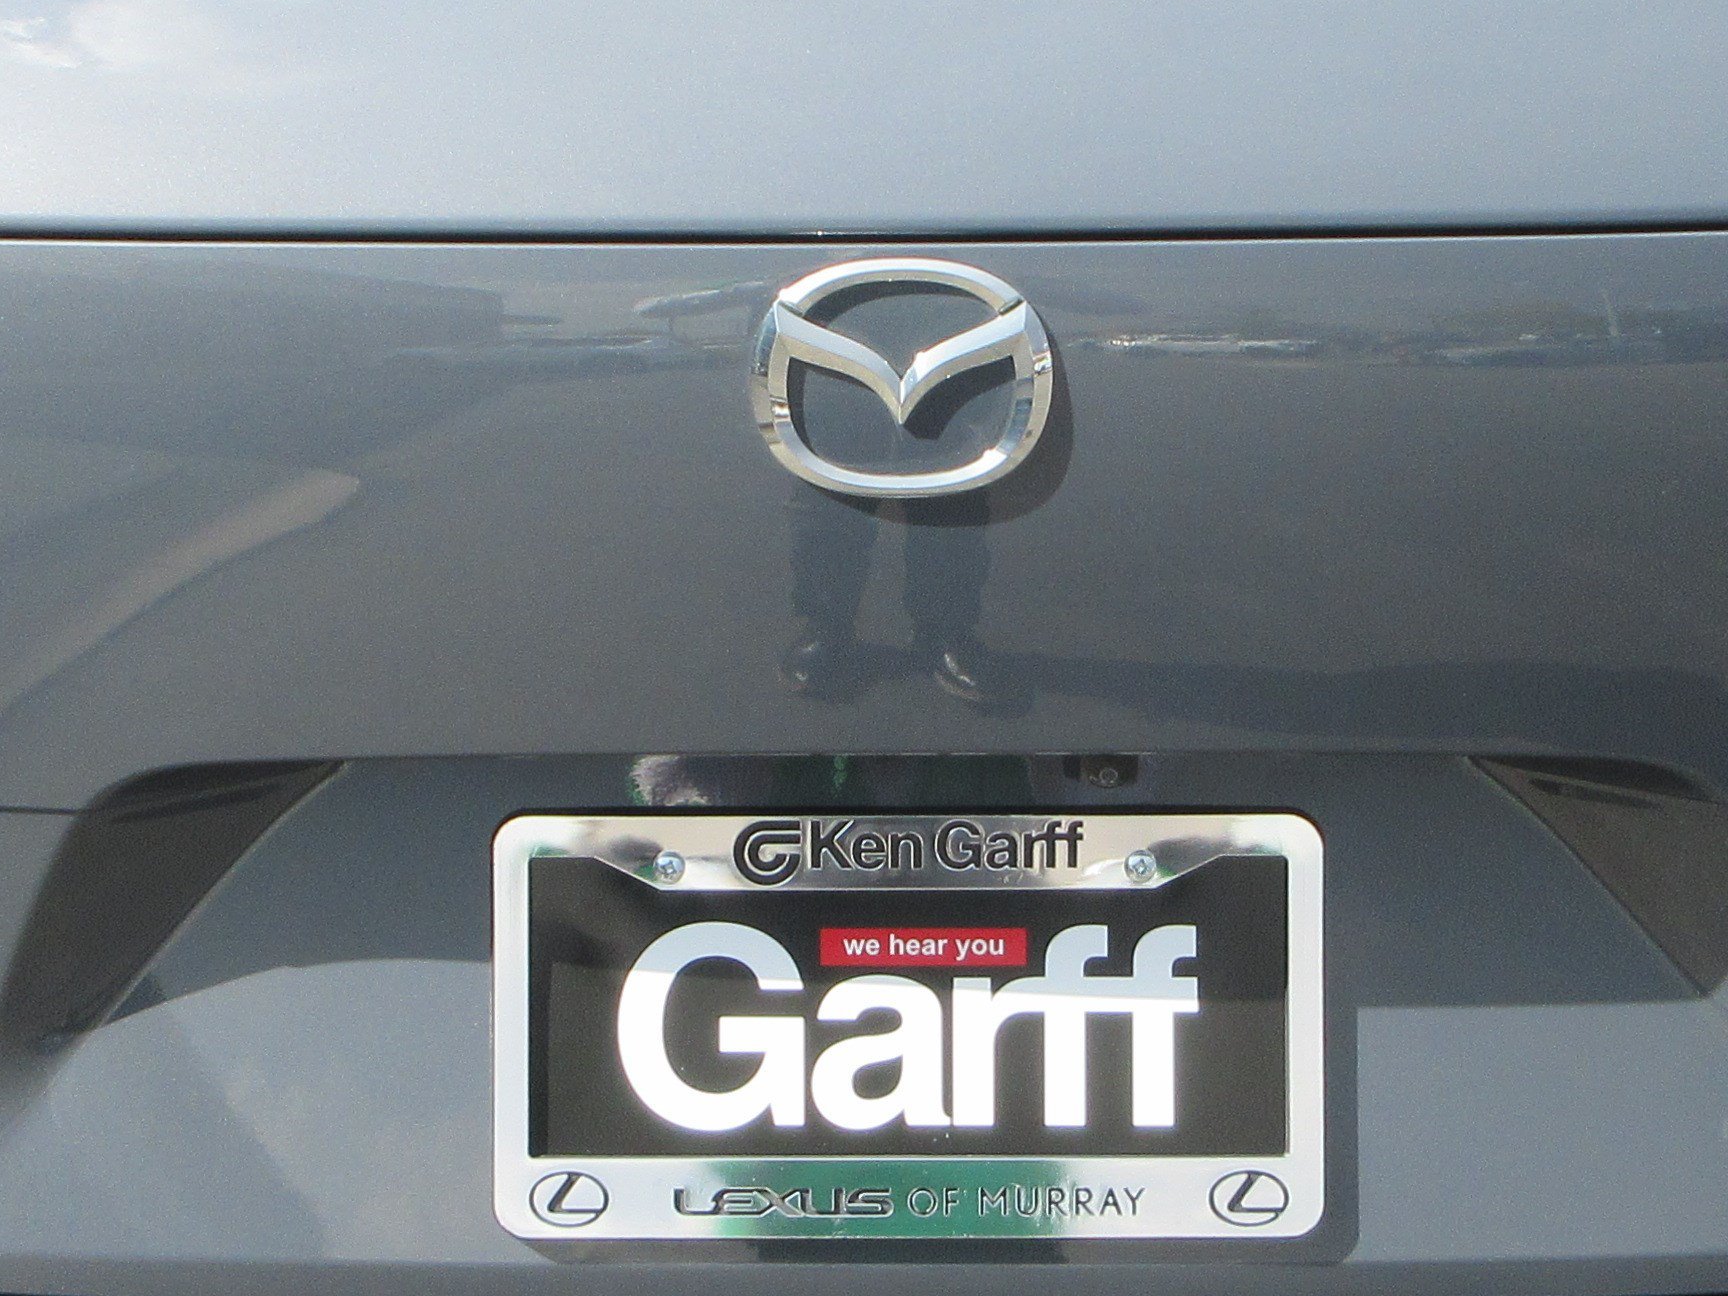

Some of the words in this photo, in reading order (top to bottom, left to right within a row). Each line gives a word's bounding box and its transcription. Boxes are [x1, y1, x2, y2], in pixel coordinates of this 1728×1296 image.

[810, 819, 924, 871] Ken
[934, 819, 1085, 872] Garff
[842, 938, 880, 957] we
[889, 933, 951, 957] hear
[955, 938, 1005, 962] you
[616, 920, 1201, 1132] Garff
[673, 1186, 895, 1219] LEXUS
[906, 1186, 958, 1218] OF
[977, 1186, 1146, 1218] MURRAY
